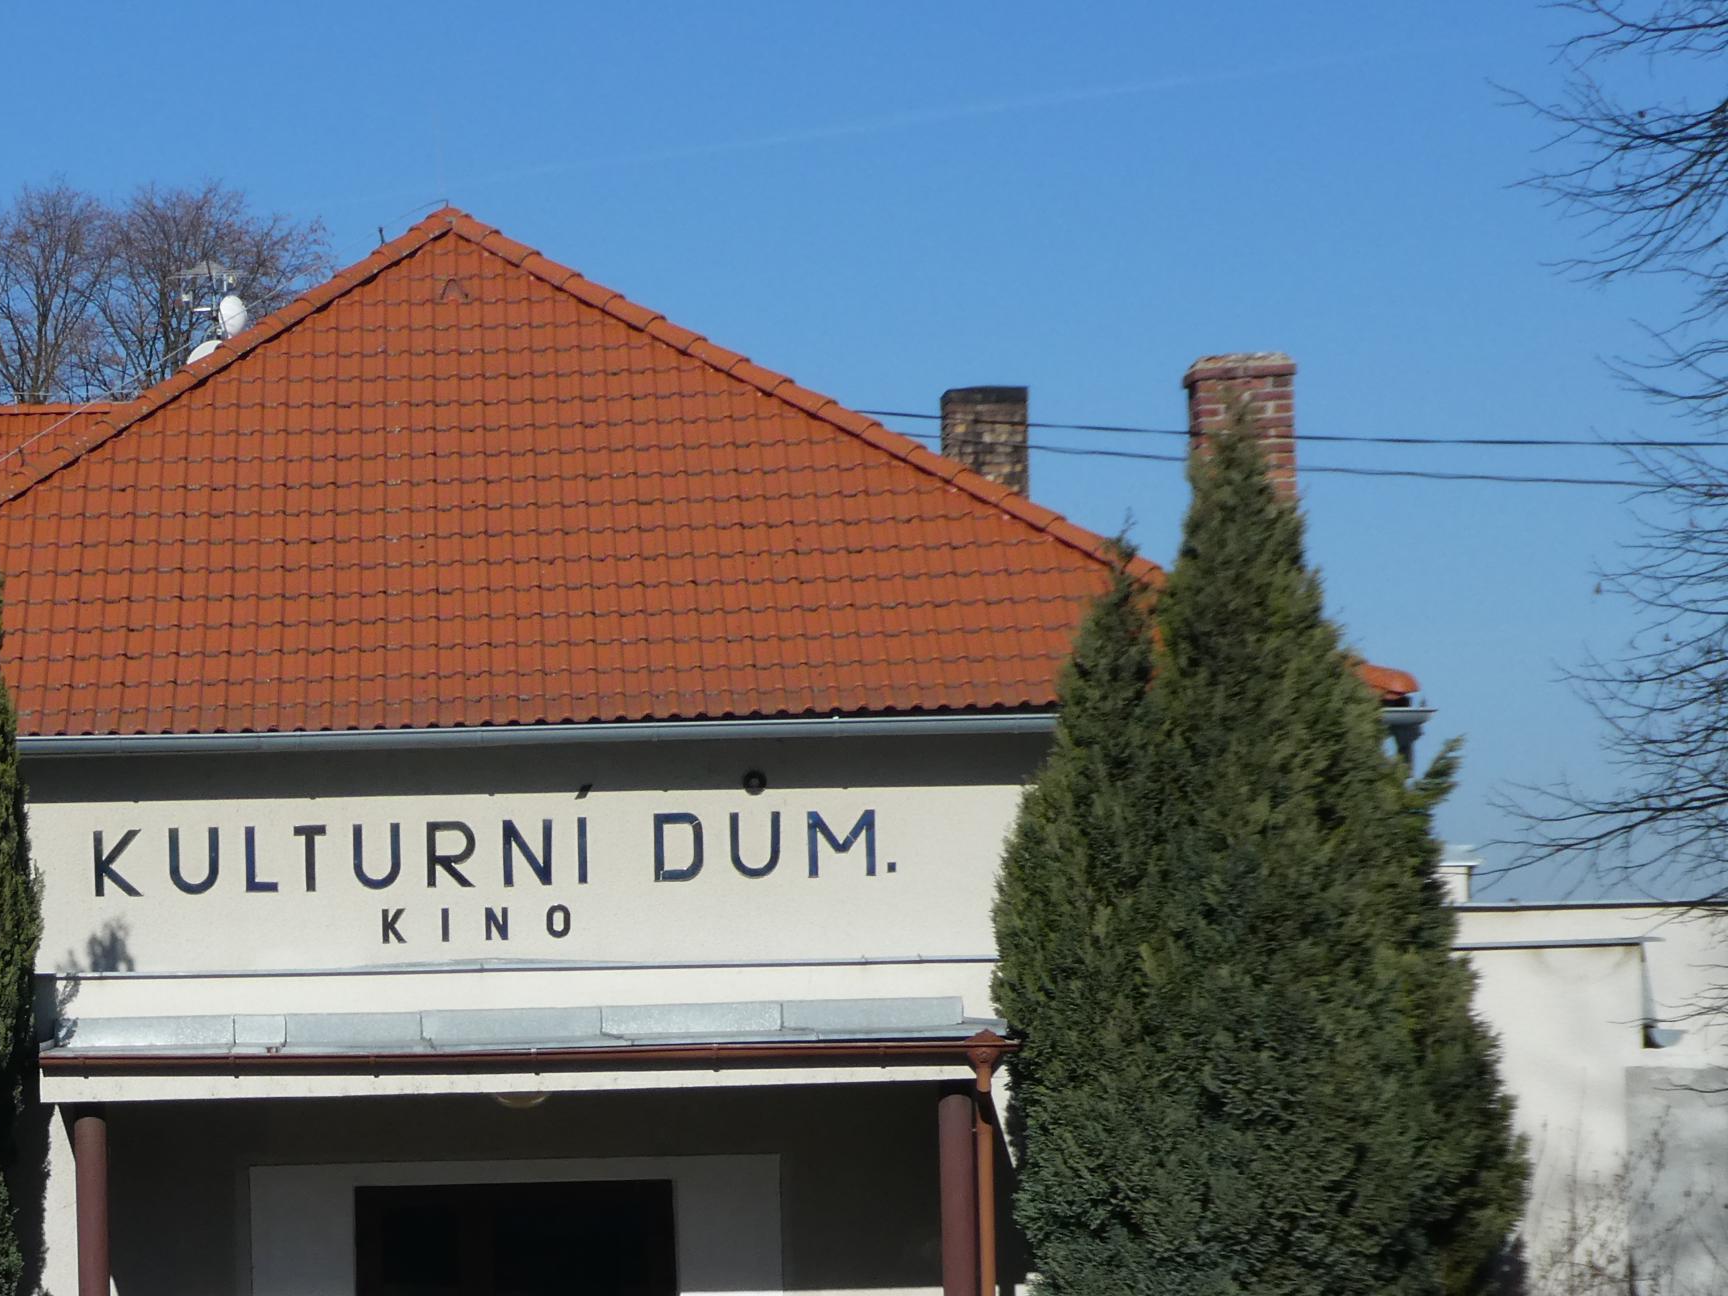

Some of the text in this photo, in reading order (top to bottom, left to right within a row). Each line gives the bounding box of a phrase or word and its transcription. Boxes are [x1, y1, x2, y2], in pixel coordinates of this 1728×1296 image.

[93, 769, 897, 898] KULTURNÍ DŮM.
[380, 903, 572, 945] KINO
